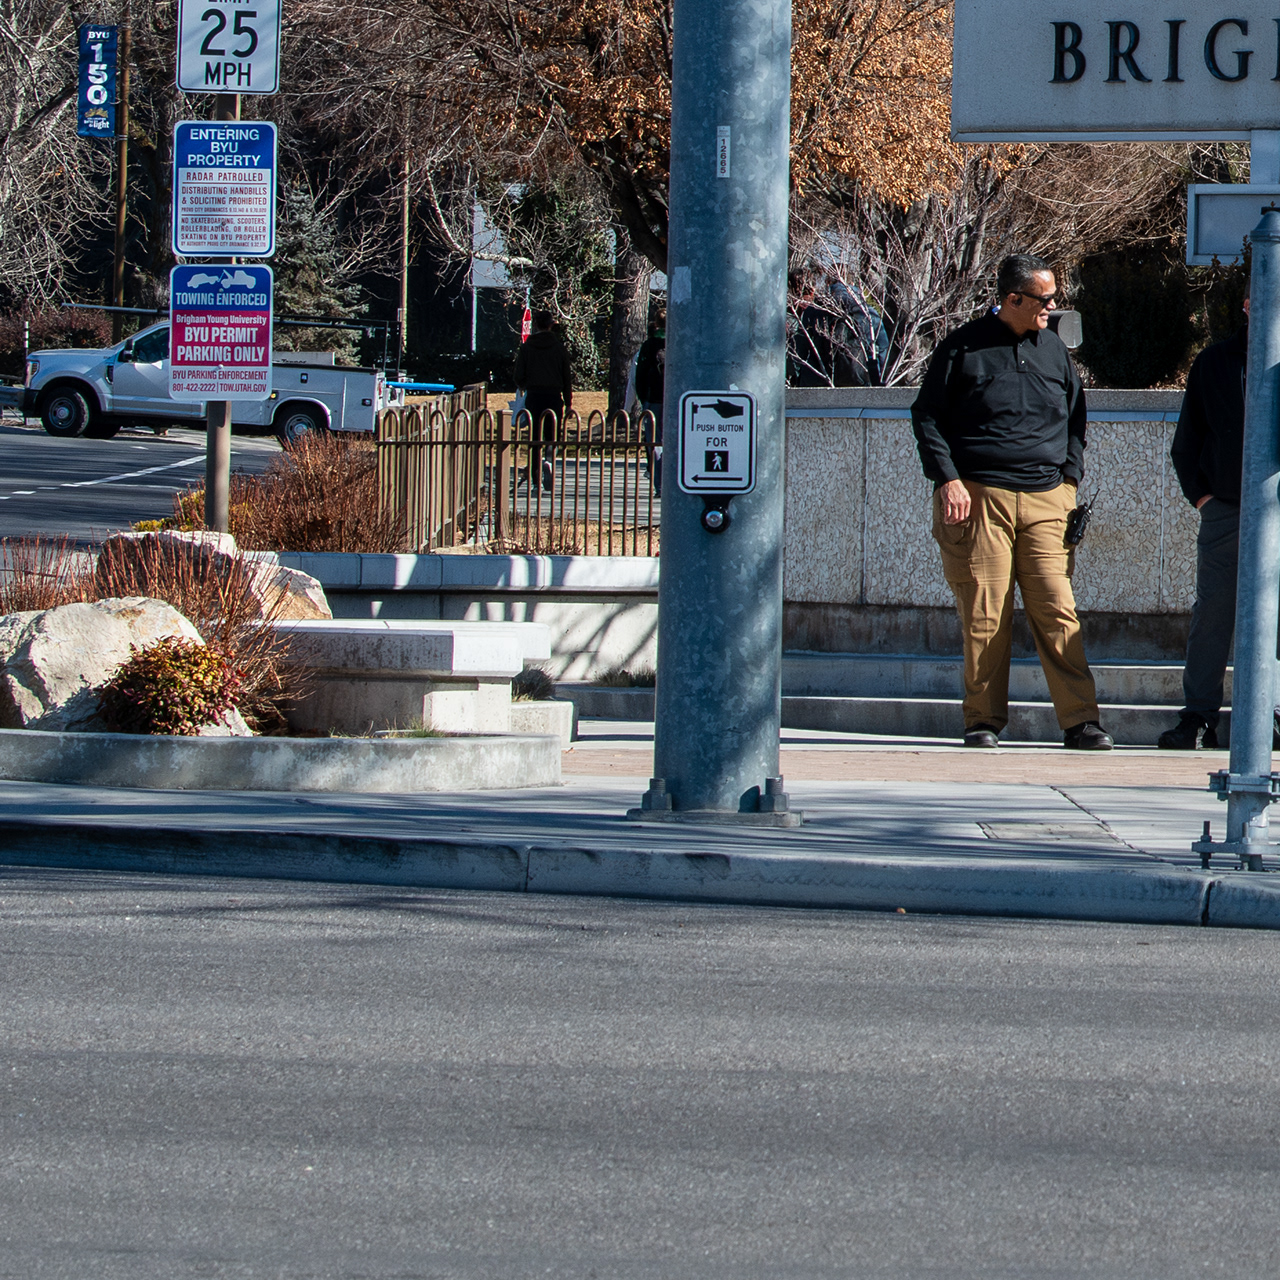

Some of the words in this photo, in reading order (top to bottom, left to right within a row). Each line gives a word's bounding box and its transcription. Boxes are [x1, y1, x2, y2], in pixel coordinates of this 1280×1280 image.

[88, 31, 110, 39] BYU
[199, 8, 259, 58] 25
[86, 43, 108, 105] 150
[204, 61, 252, 86] MPH
[190, 128, 260, 141] ENTERING
[210, 141, 239, 153] BYU
[187, 154, 261, 166] PROPERTY
[186, 172, 214, 181] RADAR
[218, 172, 263, 181] PATROLLED
[181, 186, 228, 194] DISTRIBUTING
[230, 187, 267, 195] HANDBILLS
[181, 197, 187, 205] &
[189, 197, 226, 205] SOLICITING
[228, 197, 267, 205] PROHIBITED
[175, 292, 214, 305] TOWING
[216, 293, 267, 306] ENFORCED
[176, 314, 206, 325] Brigham
[207, 315, 229, 325] Young
[229, 315, 267, 326] University
[184, 326, 209, 342] BYU
[211, 327, 258, 343] PERMIT
[177, 345, 231, 362] PARKING
[234, 346, 265, 362] ONLY
[172, 370, 186, 379] BYU
[187, 370, 217, 380] PARKING
[218, 371, 268, 380] ENFORCEMENT
[172, 383, 216, 392] 801-422-2222
[220, 383, 267, 393] TOW.UTAH.GOV
[696, 424, 715, 432] PUSH
[718, 424, 744, 432] BUTTON
[706, 437, 728, 447] FOR
